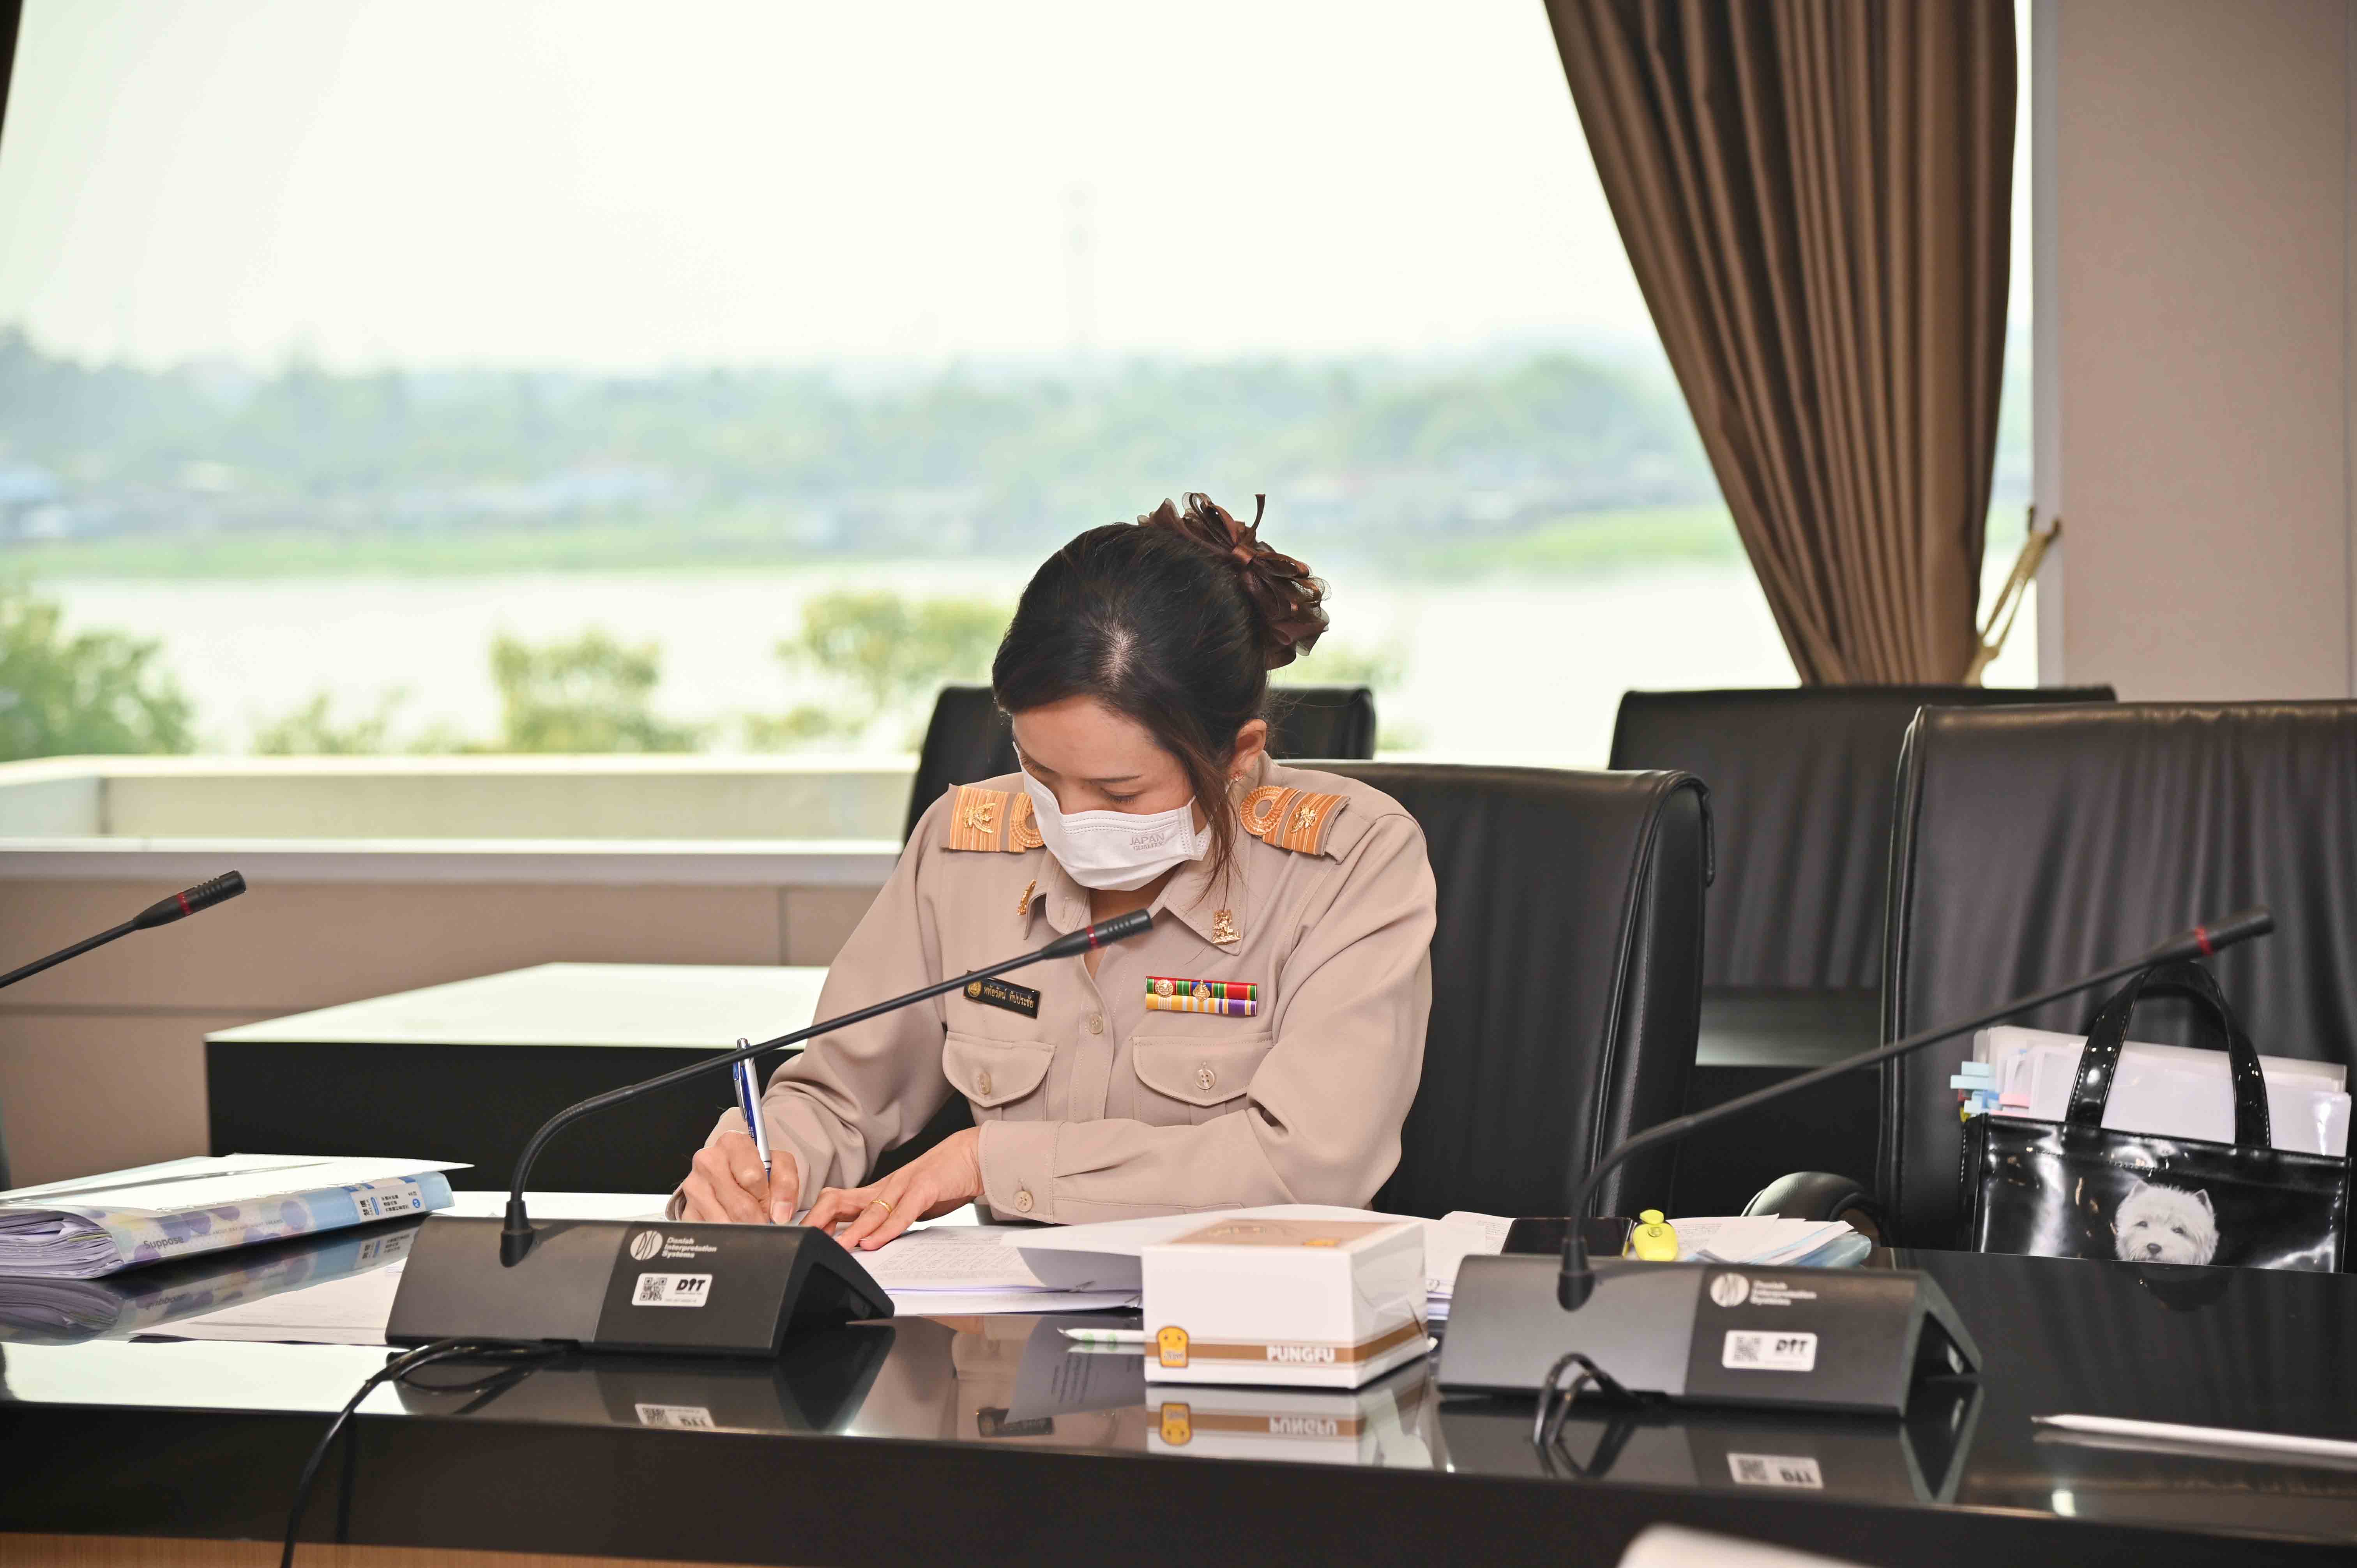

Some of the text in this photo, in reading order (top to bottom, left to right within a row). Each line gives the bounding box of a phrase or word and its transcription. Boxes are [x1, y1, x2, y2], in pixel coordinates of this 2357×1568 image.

[1130, 833, 1164, 845] JAPAN
[1134, 842, 1163, 851] QUALITY
[143, 1236, 184, 1250] Suppose
[664, 1243, 717, 1254] Interpretation
[662, 1250, 695, 1259] Systems
[1267, 1346, 1335, 1363] PUNGFU
